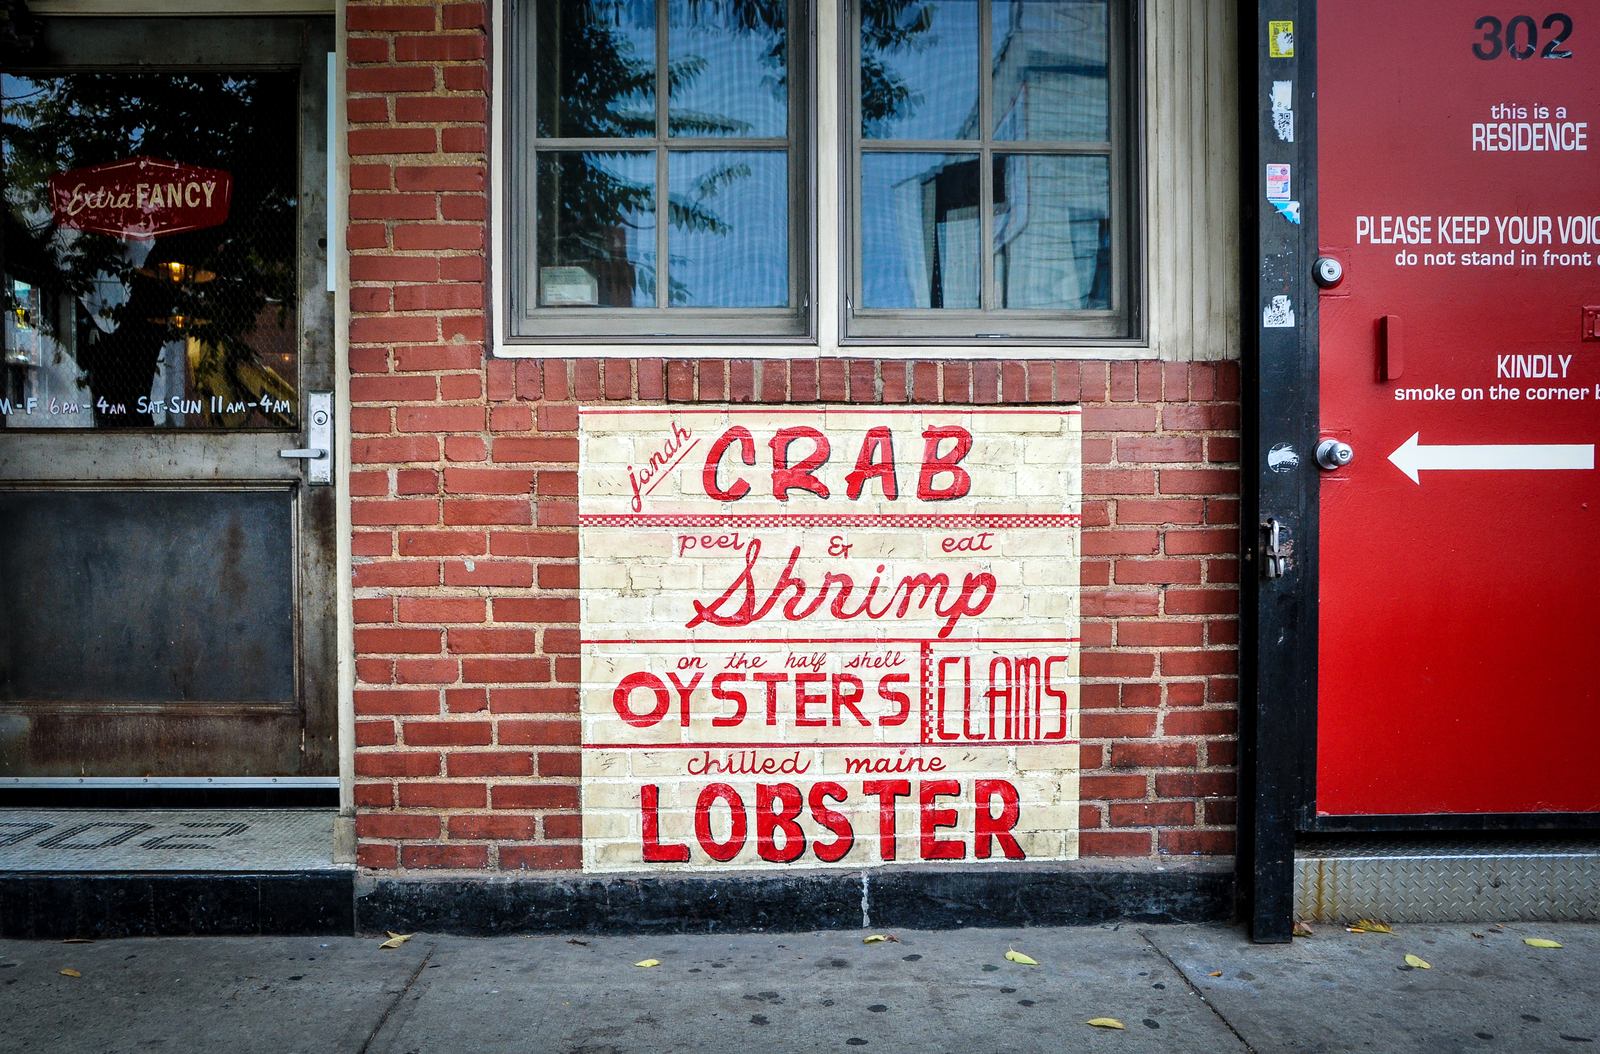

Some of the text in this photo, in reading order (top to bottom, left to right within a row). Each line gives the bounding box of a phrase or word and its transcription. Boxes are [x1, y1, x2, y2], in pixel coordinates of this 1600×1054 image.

[1472, 13, 1574, 61] 302
[1491, 103, 1567, 120] this is a
[1472, 122, 1588, 152] RESIDENCE
[67, 181, 217, 216] Extra FANCY
[1356, 215, 1432, 245] PLEASE
[1437, 215, 1490, 245] KEEP
[1494, 215, 1553, 245] YOUR
[1394, 249, 1418, 266] do
[1423, 250, 1456, 266] not
[1460, 249, 1515, 266] stand
[1520, 249, 1537, 266] in
[1542, 249, 1592, 266] front
[1496, 354, 1573, 378] KINDLY
[1394, 383, 1456, 401] smoke
[1461, 387, 1484, 401] on
[1489, 383, 1521, 401] the
[1525, 387, 1590, 401] corner
[627, 421, 692, 513] jonah
[702, 425, 973, 502] CRAB
[678, 532, 994, 559] peel & eat
[686, 538, 995, 638] Shrimp
[677, 651, 907, 673] on the half shell
[612, 671, 911, 728] OYSTERS
[937, 655, 1068, 741] CLAMS
[687, 749, 947, 775] chilled maine
[640, 778, 1027, 863] LOBSTER
